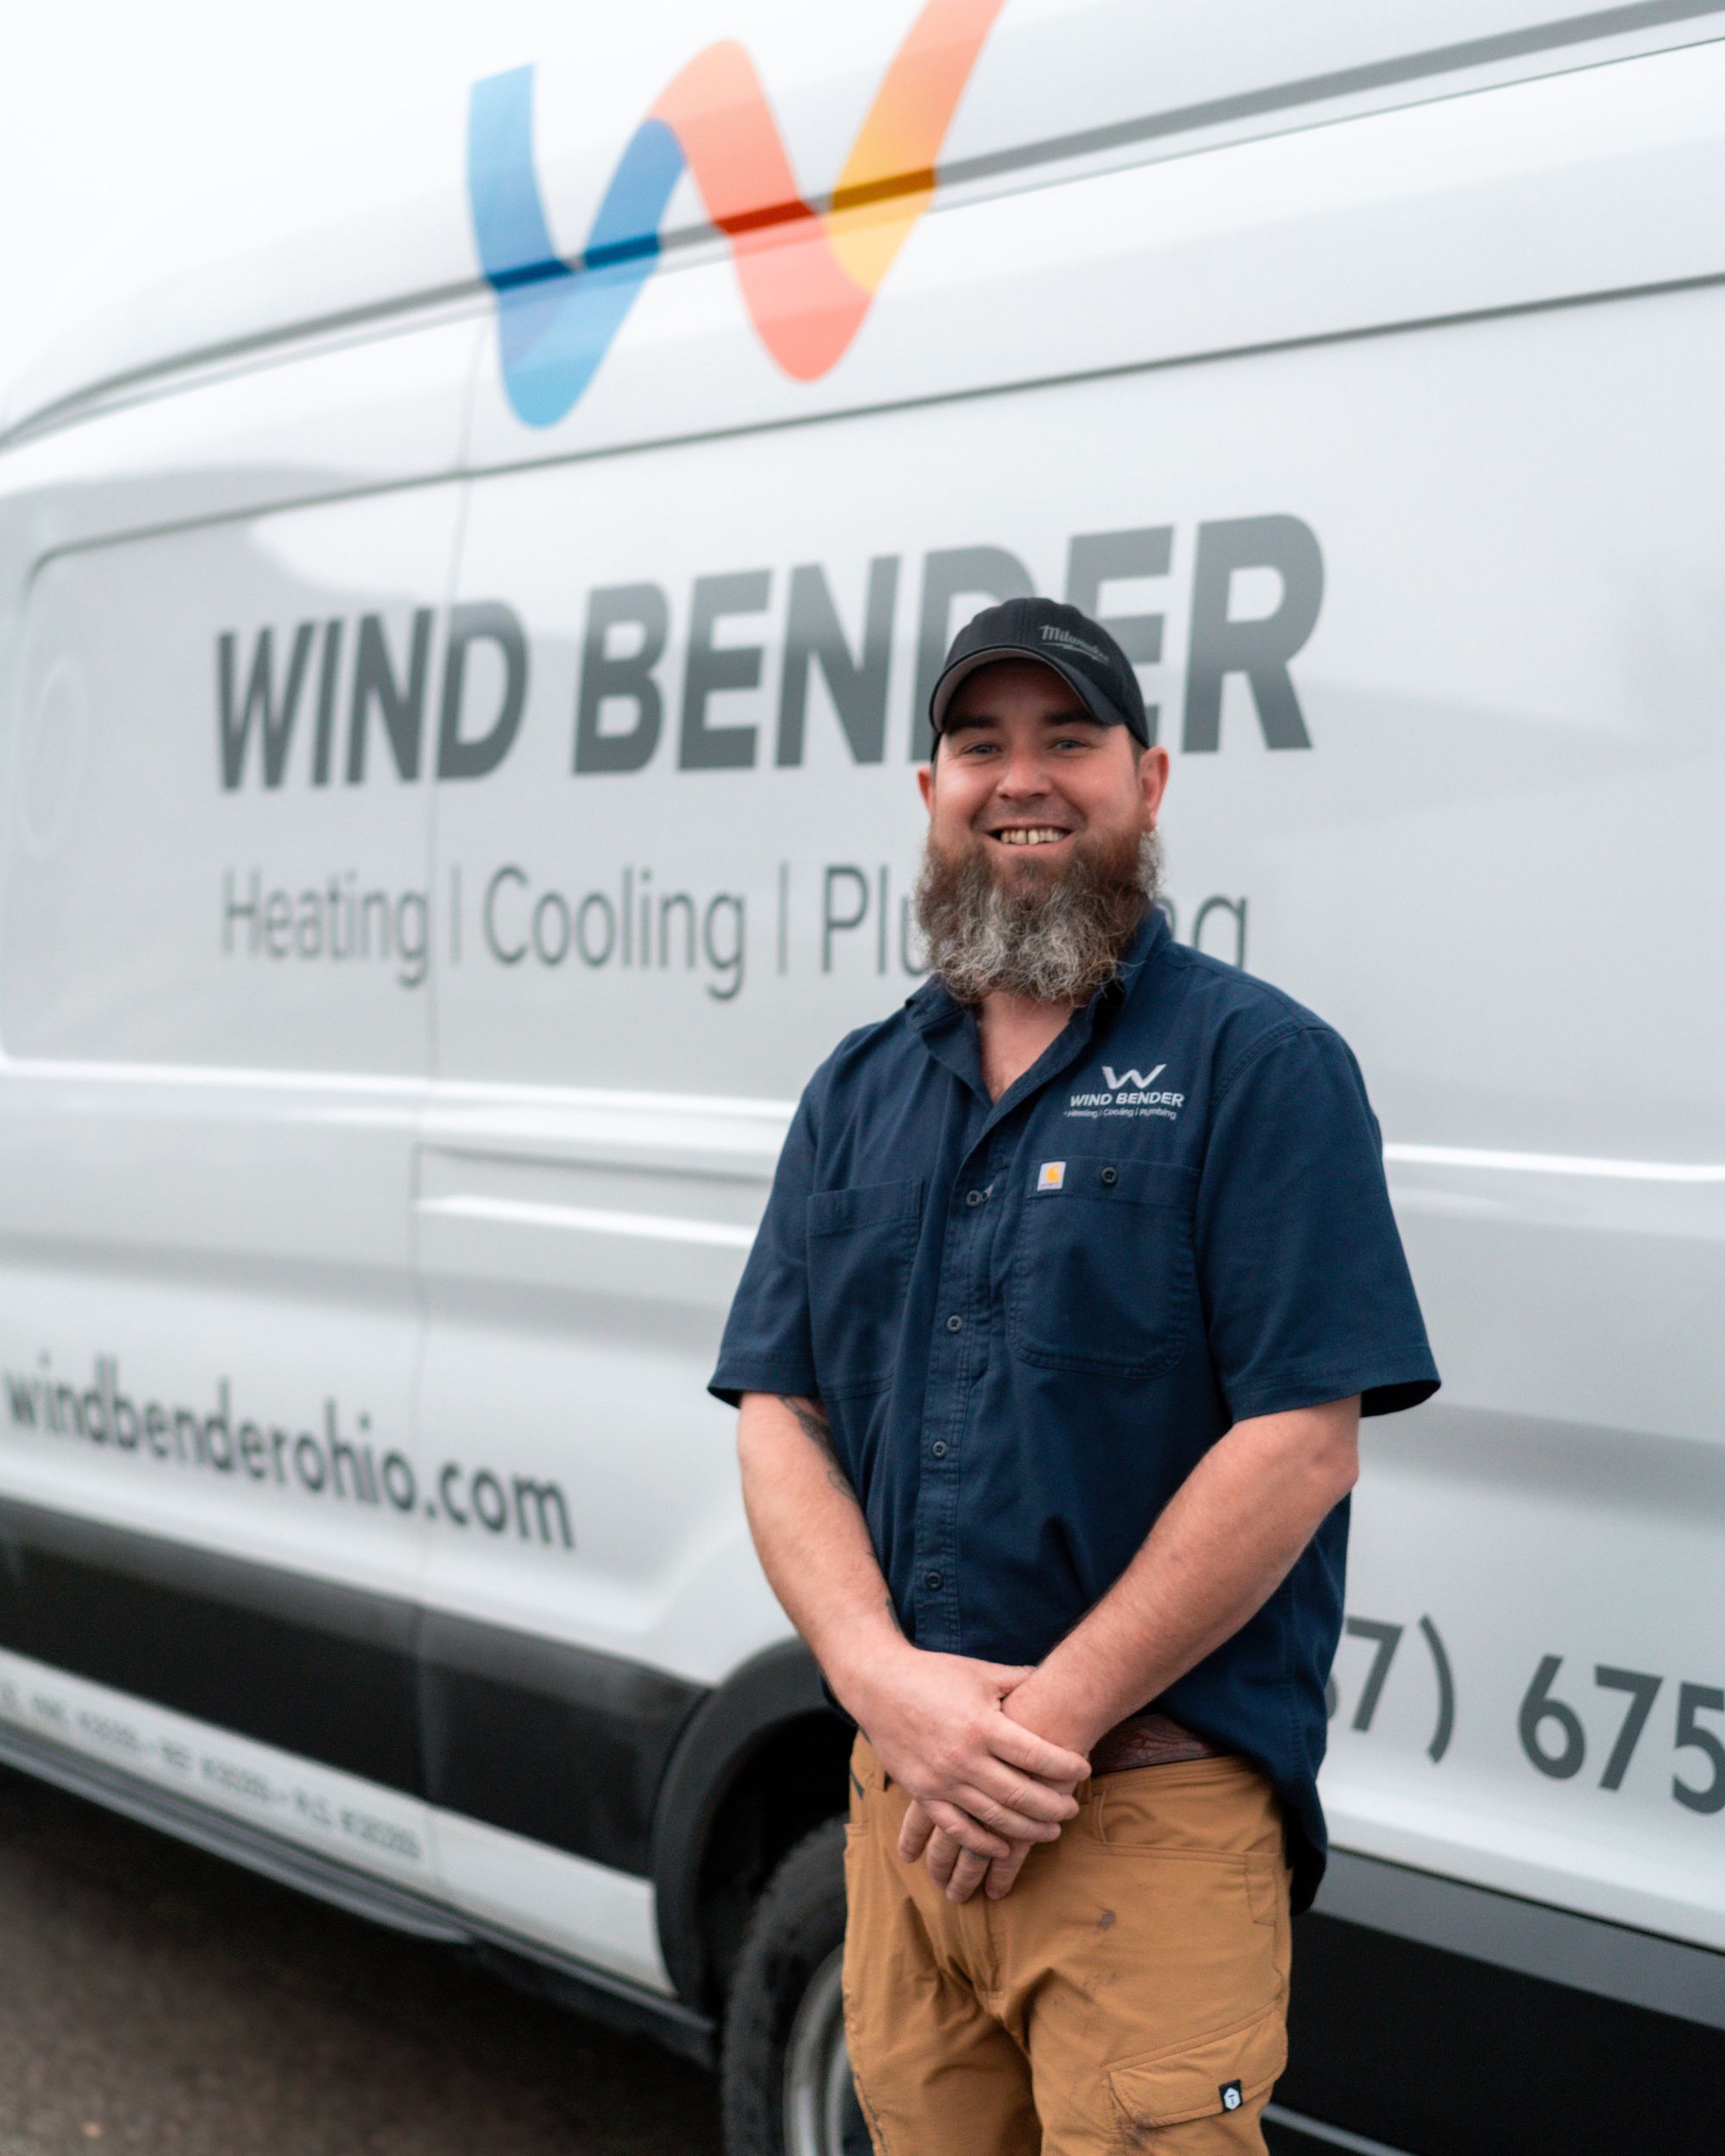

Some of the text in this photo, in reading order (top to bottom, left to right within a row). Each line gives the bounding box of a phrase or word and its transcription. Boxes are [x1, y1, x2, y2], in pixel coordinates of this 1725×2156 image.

[216, 599, 530, 793] WIND
[222, 865, 430, 989] Heating
[483, 863, 746, 1002] Cooling
[1070, 1092, 1185, 1107] WIND BENDER
[3, 1347, 574, 1549] windbenderohio.com
